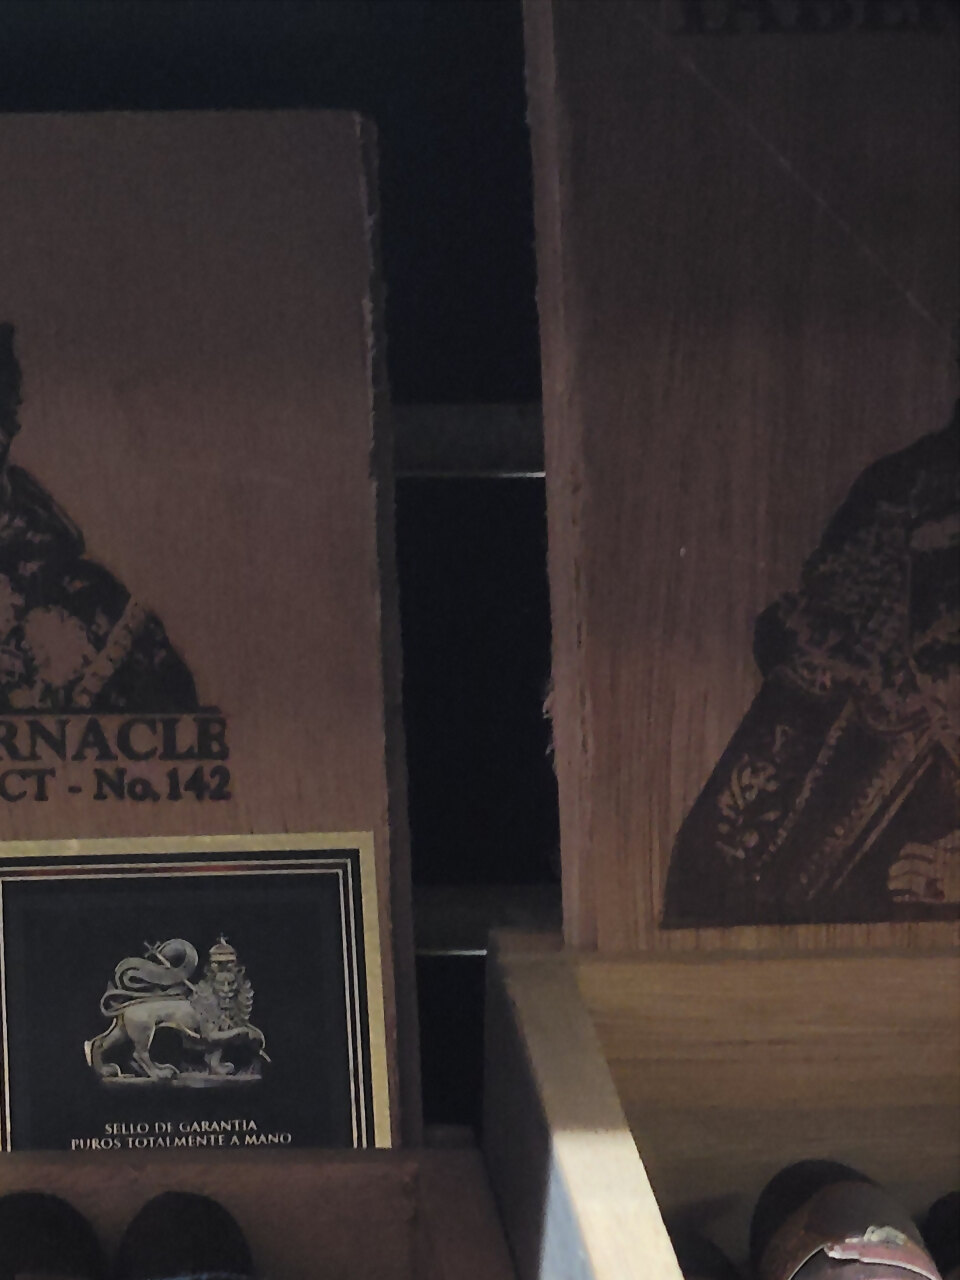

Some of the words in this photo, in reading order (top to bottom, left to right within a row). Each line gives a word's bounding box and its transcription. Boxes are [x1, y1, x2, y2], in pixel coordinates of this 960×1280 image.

[93, 764, 231, 801] No.142
[104, 1122, 149, 1135] SELLO
[155, 1122, 173, 1134] DE
[71, 1137, 122, 1151] PUROS
[127, 1134, 225, 1149] TOTALMENTE
[230, 1134, 240, 1146] A
[245, 1132, 292, 1146] MANO
